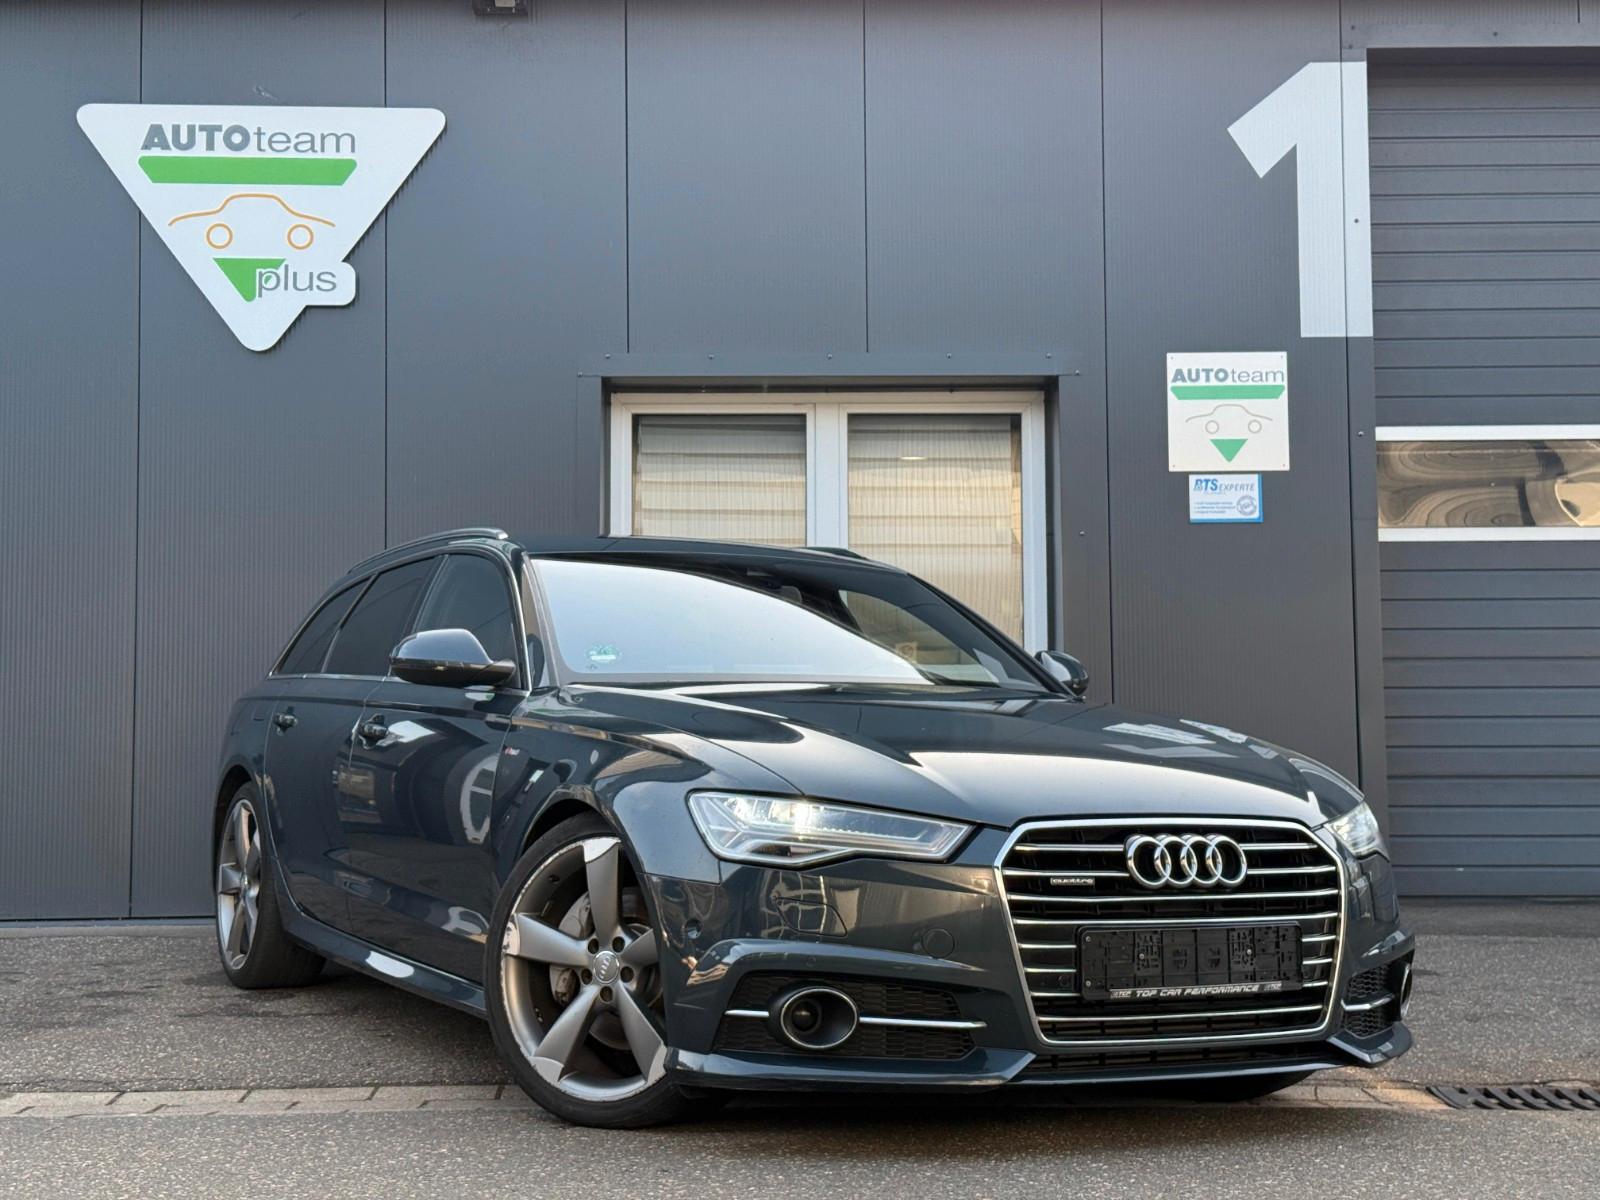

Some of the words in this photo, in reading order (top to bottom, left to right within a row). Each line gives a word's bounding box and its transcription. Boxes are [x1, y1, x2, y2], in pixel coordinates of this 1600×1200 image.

[140, 123, 356, 154] AUTOteam
[1226, 61, 1374, 338] 1
[257, 264, 337, 298] plus
[1171, 367, 1285, 384] AUTOteam
[1136, 989, 1158, 998] TOP
[1159, 988, 1182, 997] CAR
[1183, 984, 1259, 996] PERFORMANCE
